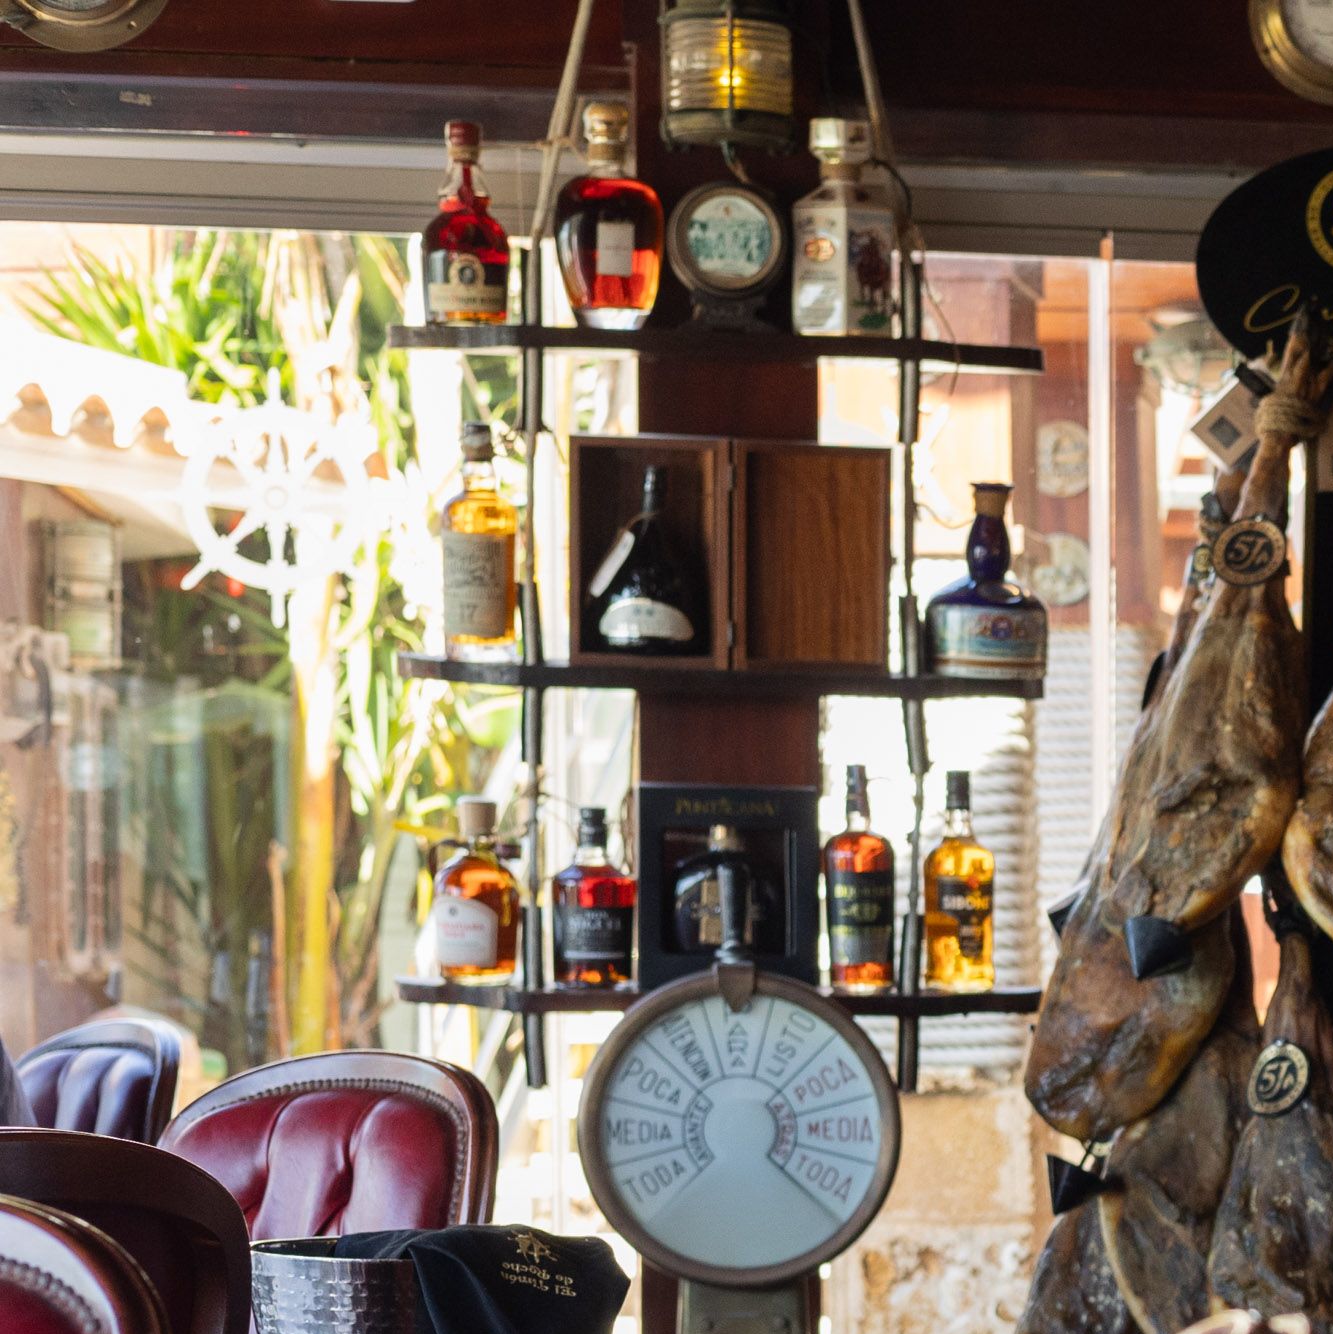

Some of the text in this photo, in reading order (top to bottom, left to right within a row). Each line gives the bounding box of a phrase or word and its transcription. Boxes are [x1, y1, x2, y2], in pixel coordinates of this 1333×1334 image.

[765, 1009, 817, 1079] LISTO
[620, 1057, 681, 1106] POCA
[793, 1057, 858, 1102] POCA
[605, 1118, 672, 1146] MEDIA
[807, 1115, 874, 1143] MEDIA
[622, 1159, 687, 1202] TODA
[796, 1154, 855, 1201] TODA
